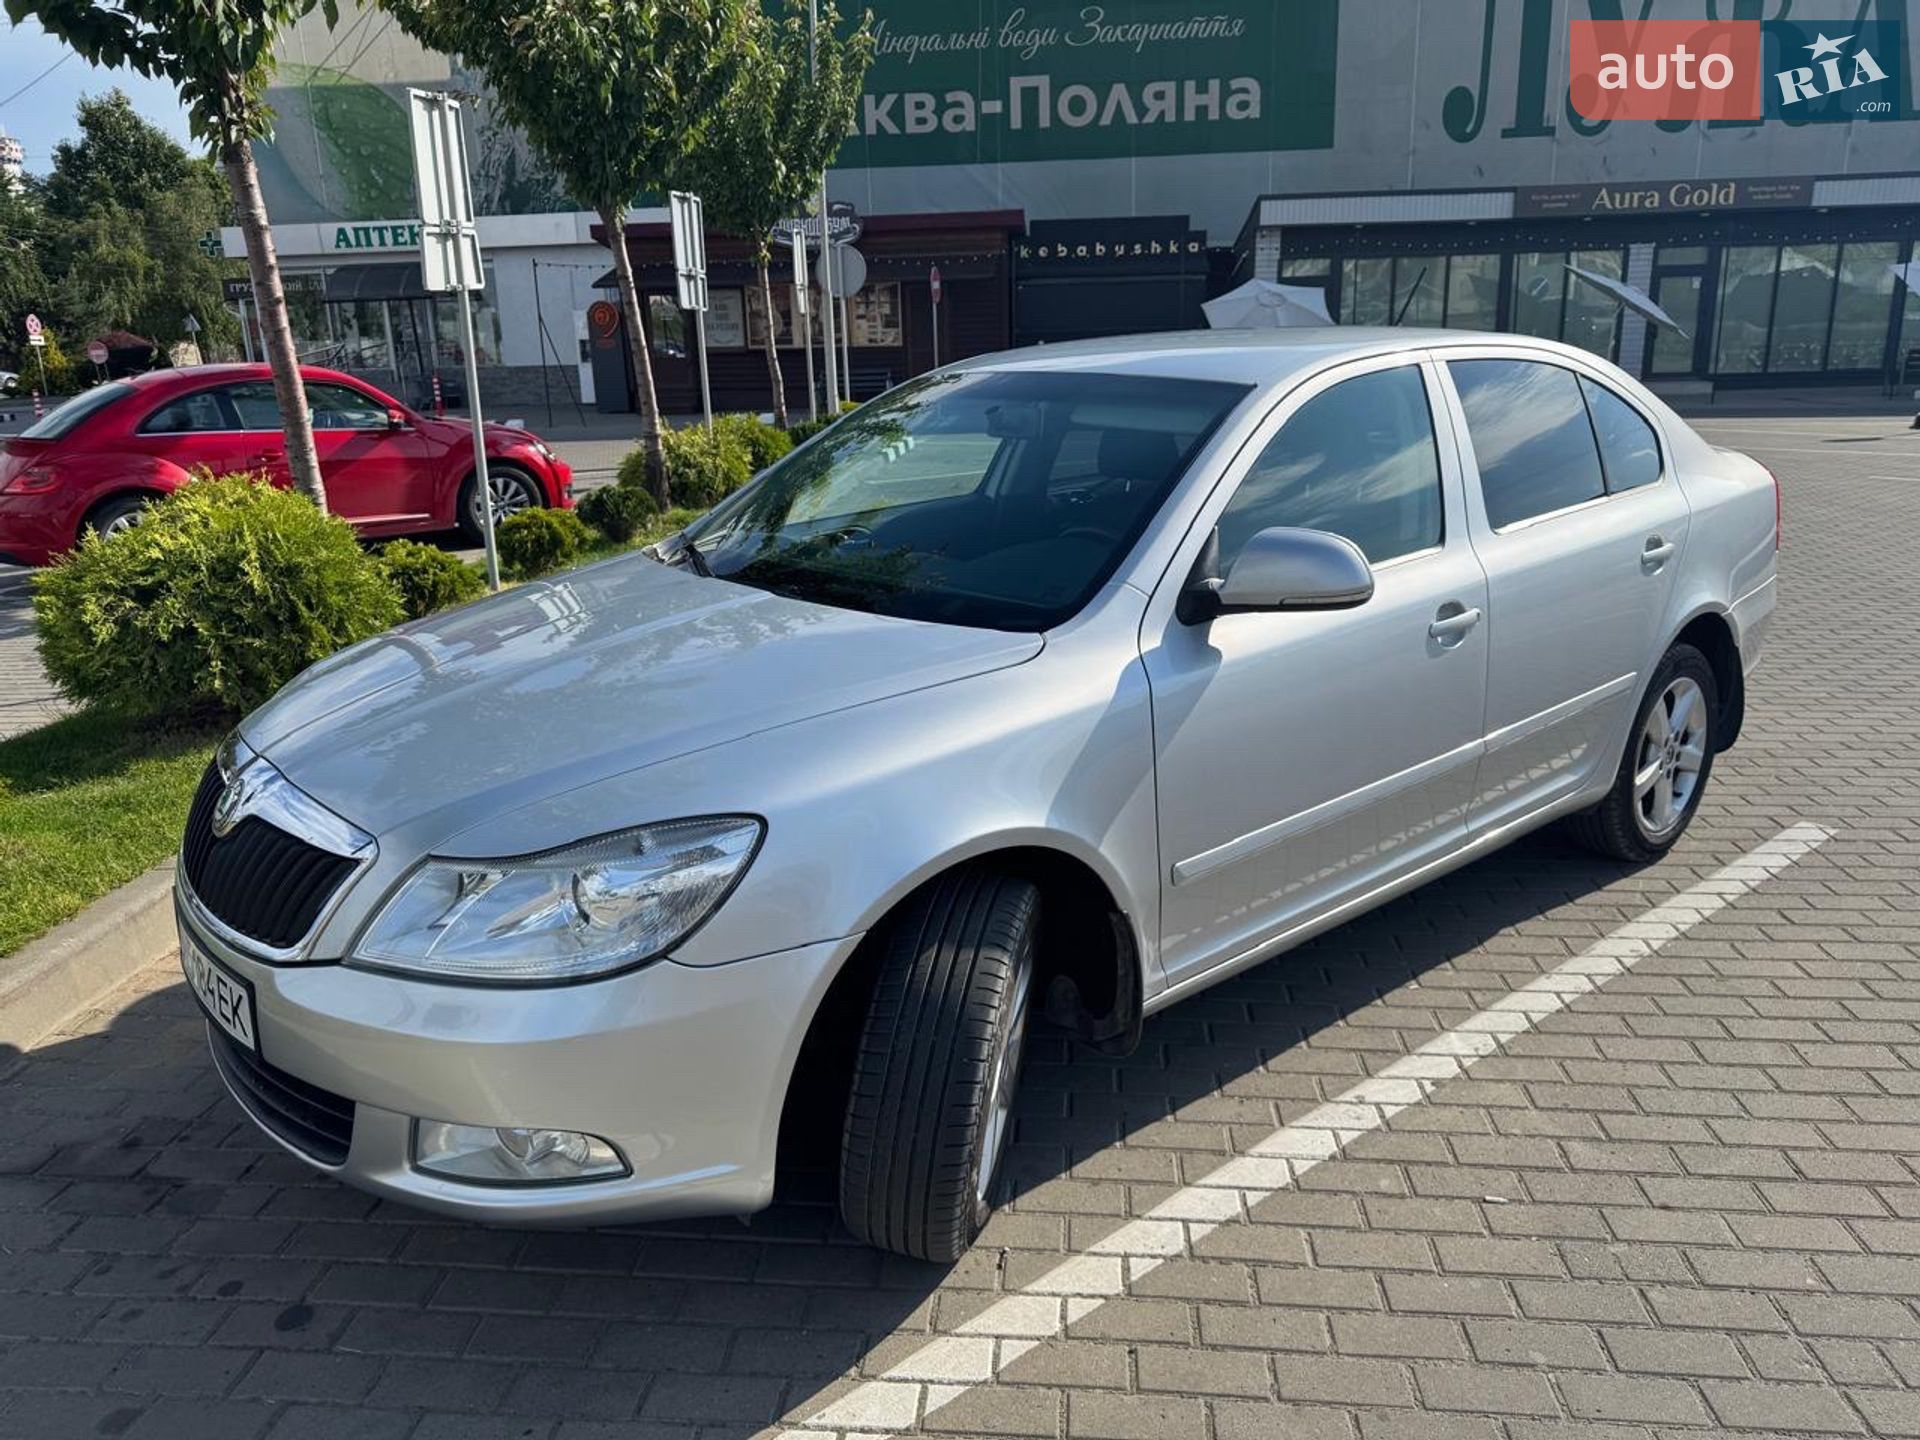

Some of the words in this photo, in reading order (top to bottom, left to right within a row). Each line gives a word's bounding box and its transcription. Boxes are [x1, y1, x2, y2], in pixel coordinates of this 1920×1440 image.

[997, 8, 1058, 60] води
[1065, 7, 1246, 53] Закарпаття
[848, 74, 1261, 136] ква-Поляна
[1591, 187, 1659, 210] Aura
[1669, 182, 1736, 207] Gold
[1019, 241, 1199, 258] kebabushka
